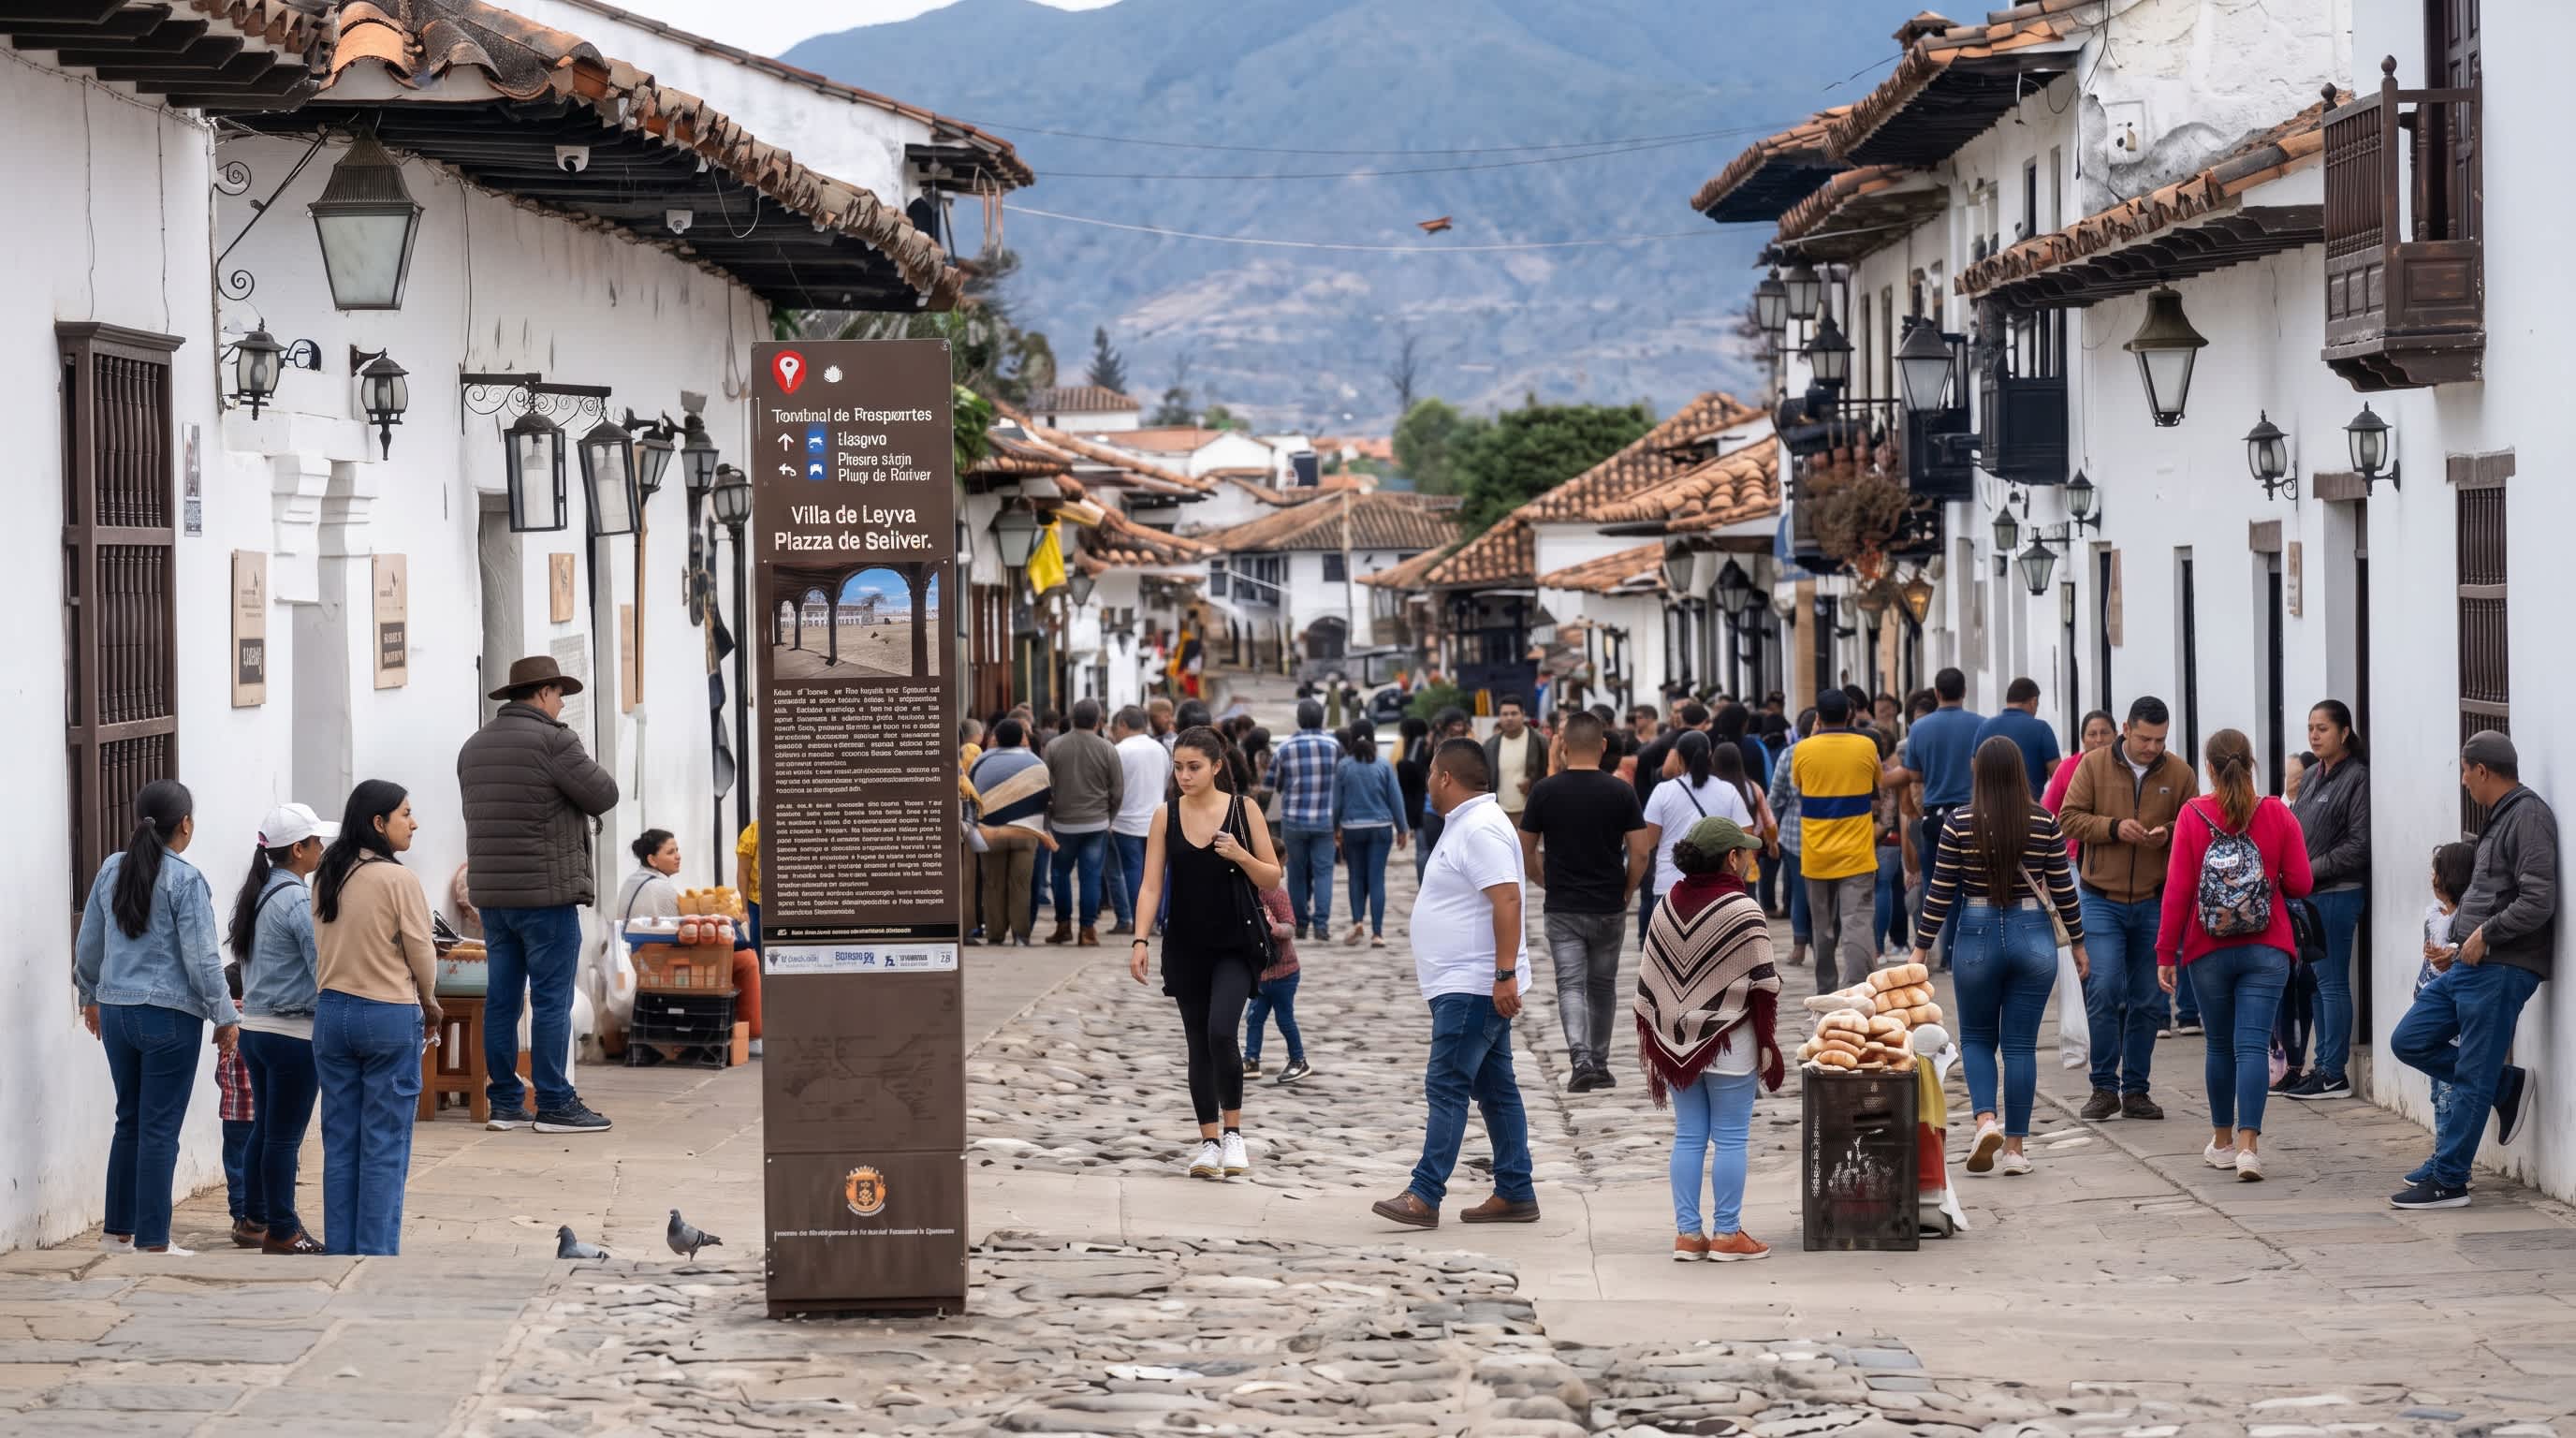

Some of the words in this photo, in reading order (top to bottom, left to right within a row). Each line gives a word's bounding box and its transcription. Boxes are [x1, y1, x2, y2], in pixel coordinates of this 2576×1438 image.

[834, 407, 850, 422] de
[872, 468, 886, 482] de
[791, 505, 831, 525] Villa
[835, 504, 857, 524] de
[862, 505, 917, 528] Leyva
[774, 531, 834, 550] Plazza
[838, 530, 861, 550] de
